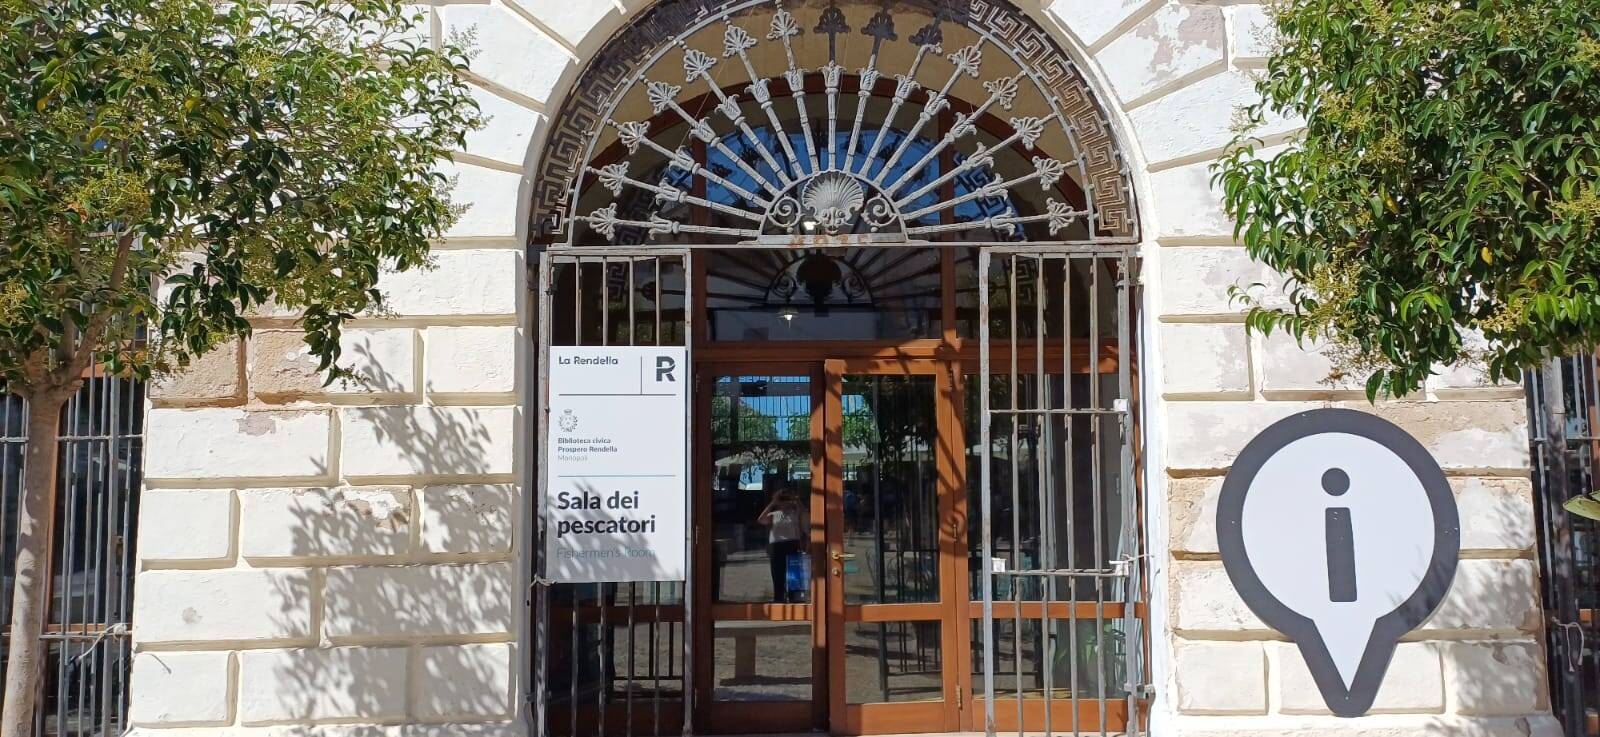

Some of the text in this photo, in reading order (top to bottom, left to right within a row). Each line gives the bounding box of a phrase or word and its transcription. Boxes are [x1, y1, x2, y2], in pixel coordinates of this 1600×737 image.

[559, 356, 619, 365] La Rendella
[655, 356, 676, 382] R
[558, 446, 588, 454] Prospero
[557, 490, 639, 510] Sala dei
[557, 514, 656, 538] pescatori
[557, 545, 656, 560] Fishermen's Room
